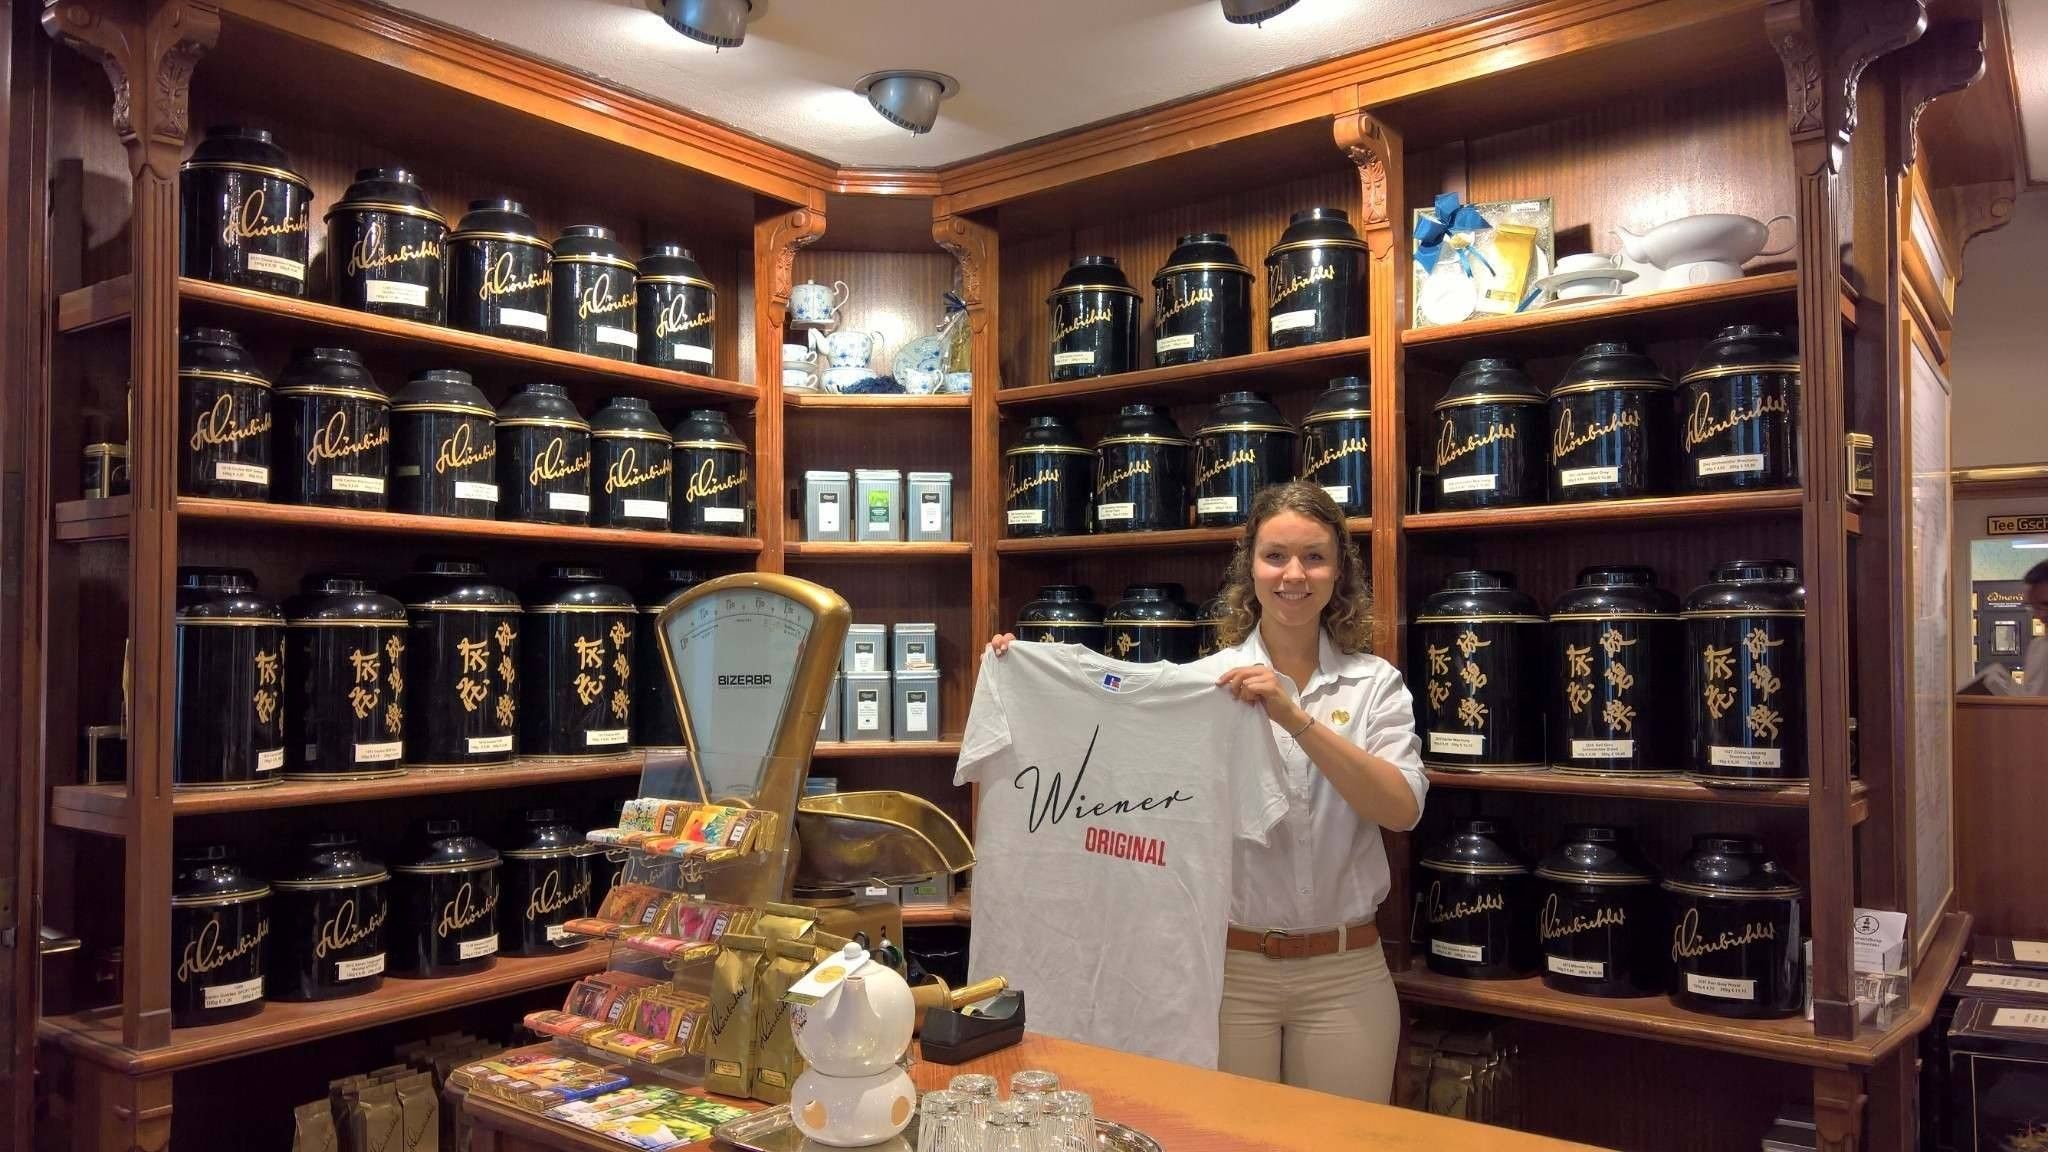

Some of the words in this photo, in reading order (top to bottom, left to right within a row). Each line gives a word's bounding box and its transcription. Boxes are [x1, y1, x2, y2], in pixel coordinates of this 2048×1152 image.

[1992, 518, 2015, 531] Tee
[718, 674, 772, 686] BIZERBA
[1015, 722, 1193, 832] Wiener
[1084, 827, 1168, 867] ORIGINAL
